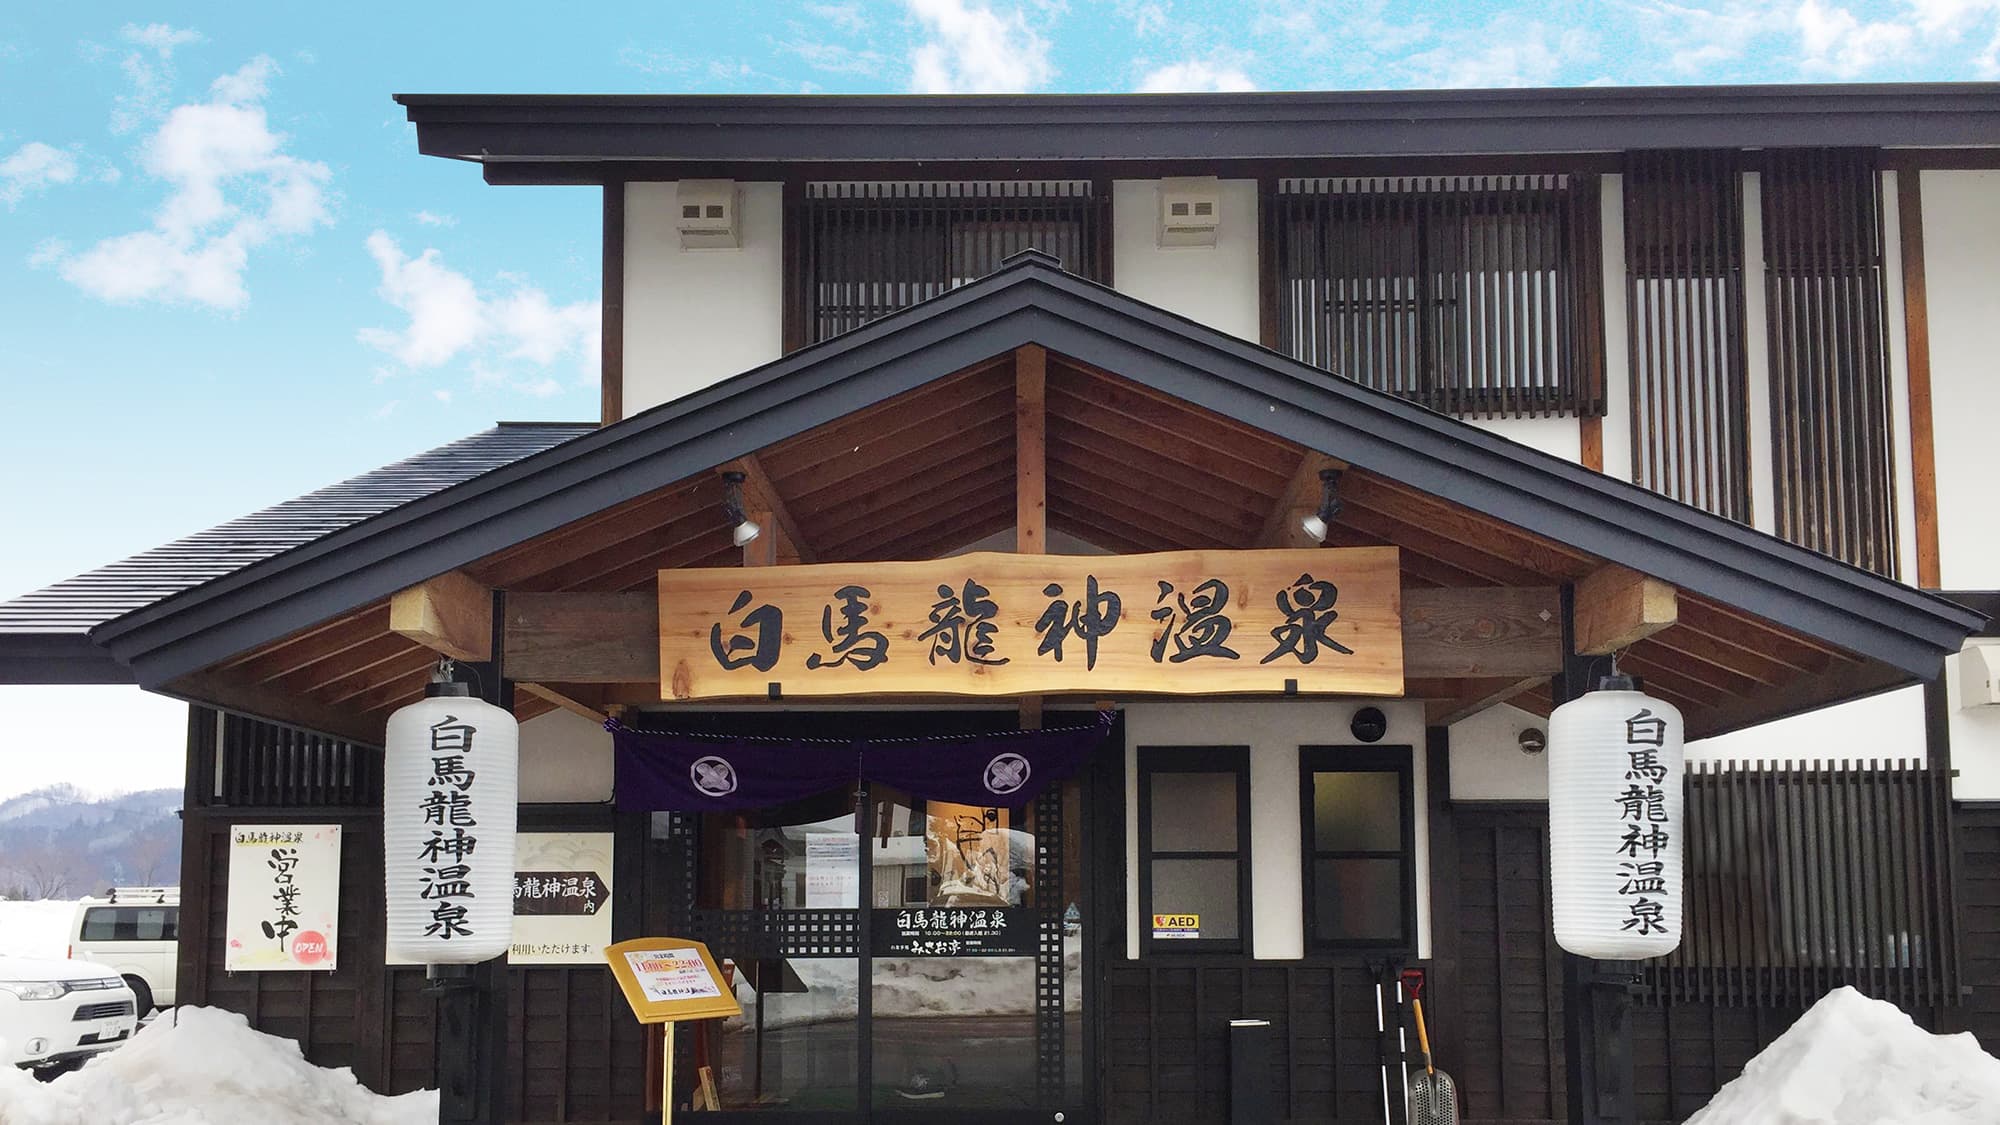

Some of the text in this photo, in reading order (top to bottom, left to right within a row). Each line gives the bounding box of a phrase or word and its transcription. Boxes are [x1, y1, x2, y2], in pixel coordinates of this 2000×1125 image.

[710, 574, 1354, 673] 白馬龍神温泉
[417, 714, 477, 940] 白馬龍神温泉
[1614, 708, 1670, 936] 白馬龍神温泉
[261, 848, 301, 952] 営業中
[295, 942, 324, 953] OPEN
[897, 910, 1007, 929] 白馬龍神温泉
[1168, 917, 1195, 926] AED
